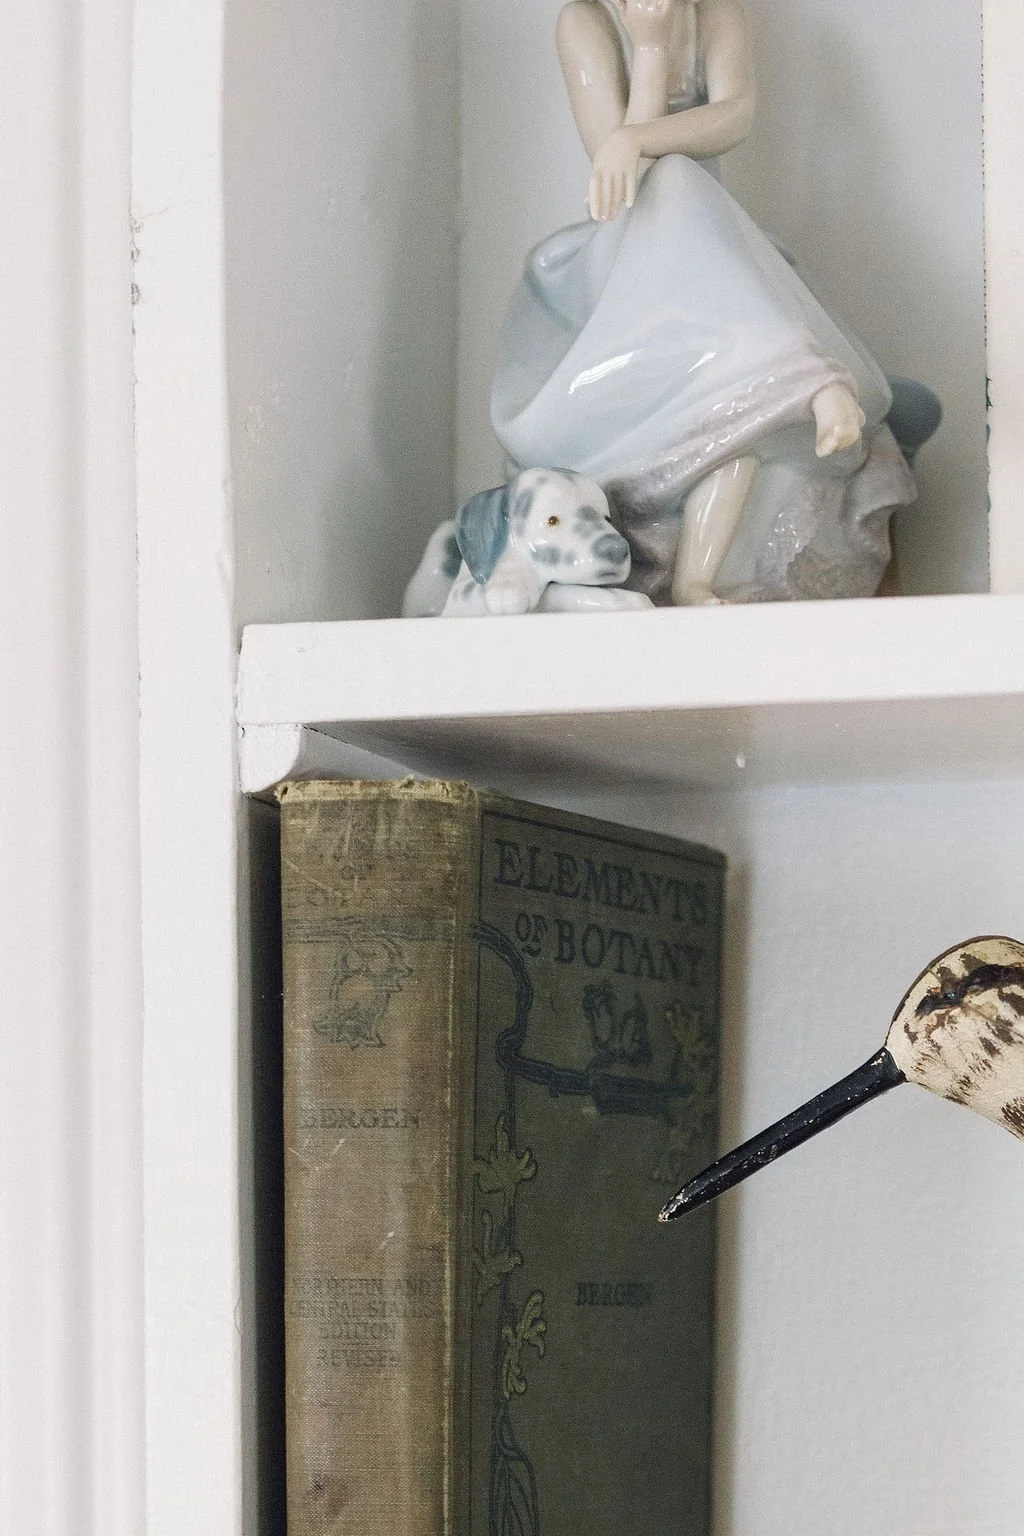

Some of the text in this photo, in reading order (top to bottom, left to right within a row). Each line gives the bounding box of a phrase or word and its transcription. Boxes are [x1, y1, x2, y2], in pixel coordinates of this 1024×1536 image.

[494, 838, 707, 926] ELEMENTS
[514, 910, 704, 986] OF BOTANY
[299, 1108, 421, 1129] BERGEN
